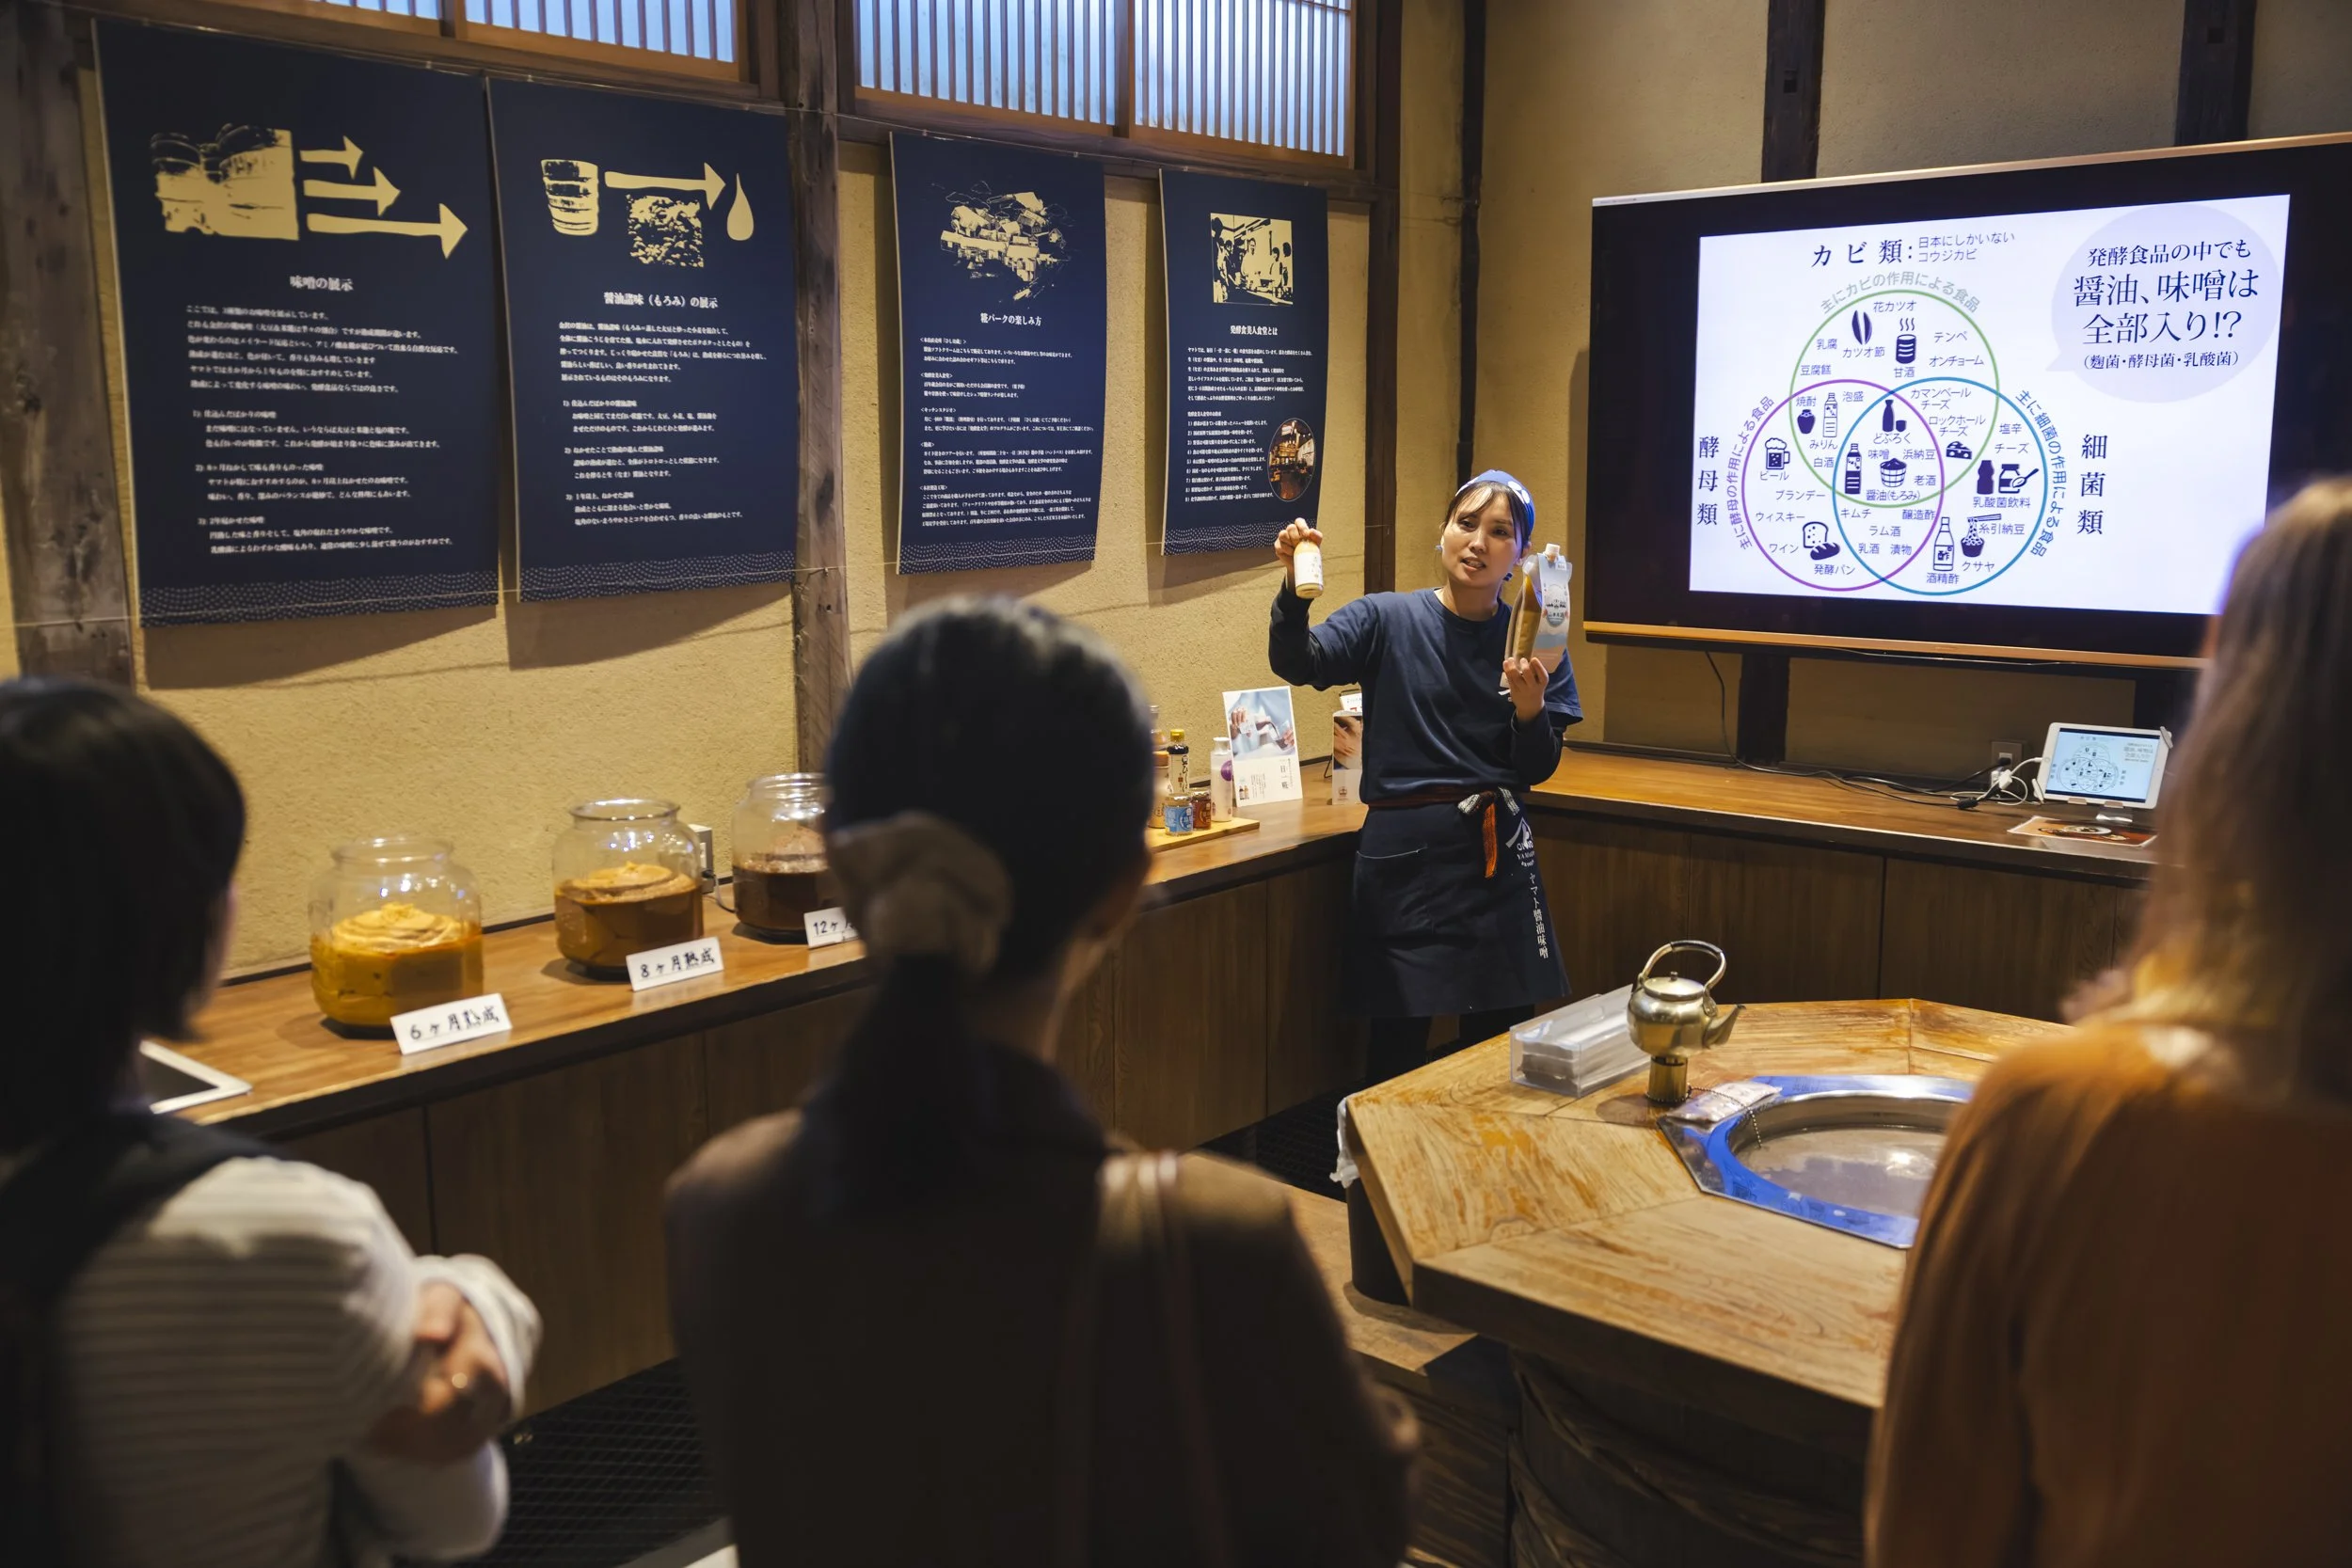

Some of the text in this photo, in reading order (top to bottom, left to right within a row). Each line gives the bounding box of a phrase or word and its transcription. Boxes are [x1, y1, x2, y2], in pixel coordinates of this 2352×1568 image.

[1918, 232, 2015, 248] 日本にしかいない
[1918, 248, 1978, 262] コウジカビ
[2088, 240, 2250, 267] 発酵食品の中でも
[290, 276, 354, 292] 味噌の展示
[2074, 269, 2259, 307] 醤油、味噌は
[1820, 271, 1980, 314] 主にカビの作用による食品
[1873, 300, 1916, 312] 花カツオ
[2083, 311, 2242, 344] 全部入り!?
[1934, 331, 1967, 343] テンペ
[1817, 339, 1838, 350] 乳腐
[1843, 346, 1885, 358] カツオ節
[1929, 355, 1984, 367] オンチョーム
[1894, 367, 1915, 378] 甘酒
[1842, 391, 1864, 402] 泡盛
[1911, 388, 1971, 400] カマンベール
[1796, 396, 1817, 406] 焼酎
[1920, 400, 1950, 410] チーズ
[1929, 415, 1986, 426] ロックホール
[1939, 426, 1968, 437] チーズ
[1999, 423, 2022, 435] 塩辛
[1809, 439, 1838, 450] みりん
[1872, 434, 1911, 444] どぶろく
[1994, 443, 2029, 454] チーズ
[1867, 450, 1890, 460] 味噌
[1902, 449, 1936, 460] 浜納豆
[1813, 457, 1835, 468] 白酒
[1726, 396, 1774, 549] 主に酵母の作用による食品
[1759, 470, 1789, 481] ビール
[2015, 389, 2067, 557] 主に細菌の作用による食品
[1697, 436, 1720, 526] 酵母類
[1914, 475, 1936, 486] 老酒
[2077, 434, 2107, 535] 細菌類
[1776, 490, 1826, 500] ブランデー
[1973, 497, 2031, 508] 乳酸菌飲料
[1756, 512, 1805, 522] ウィスキー
[1840, 509, 1871, 519] キムチ
[1868, 525, 1901, 537] ラム酒
[1978, 523, 2026, 535] 糸引納豆
[1769, 543, 1799, 554] ワイン
[1858, 543, 1880, 554] 乳酒
[1890, 544, 1912, 555] 漬物
[1814, 564, 1855, 575] 発酵パン
[1962, 561, 1994, 572] クサヤ
[1926, 572, 1960, 584] 酒精酢
